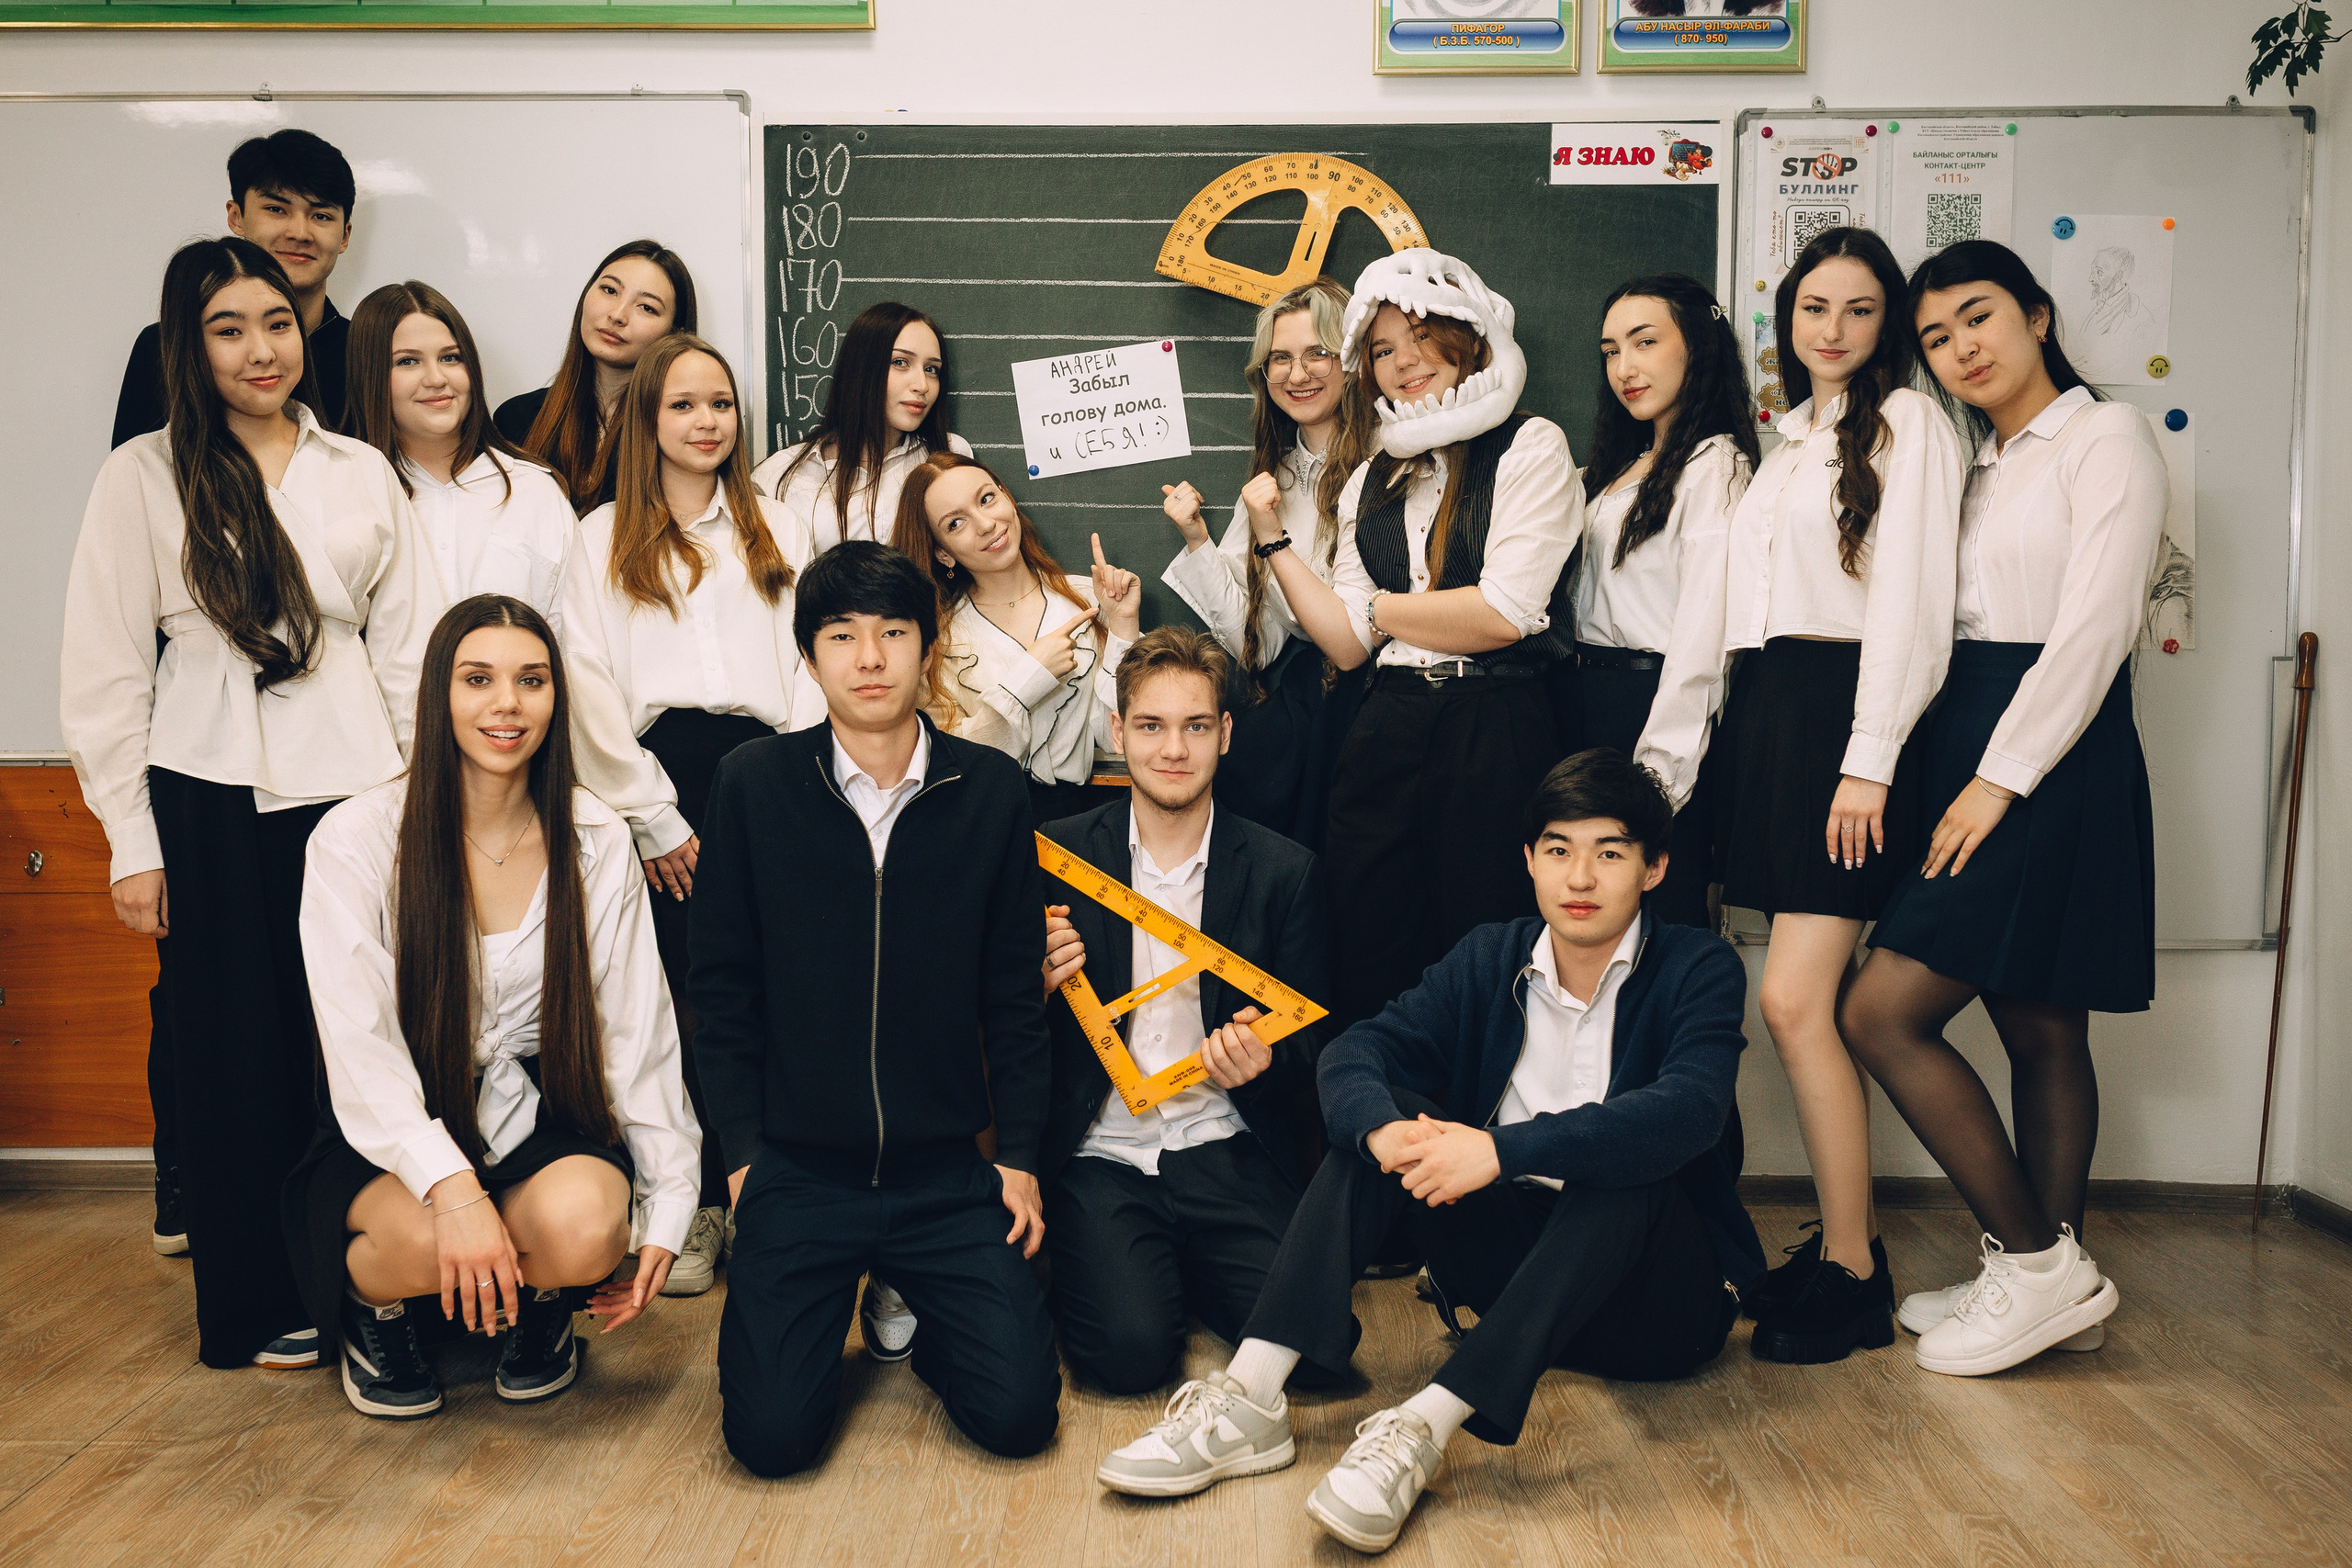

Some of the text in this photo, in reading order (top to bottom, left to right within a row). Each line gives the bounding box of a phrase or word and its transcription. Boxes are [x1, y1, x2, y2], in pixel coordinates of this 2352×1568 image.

[1451, 23, 1506, 34] ПИФАГОР
[1473, 36, 1513, 46] 570-500
[1634, 20, 1771, 32] АБУ НАСЫР ӘЛ-ФАРАБИ
[786, 142, 851, 199] 190
[1553, 146, 1656, 166] Я ЗНАЮ
[1912, 151, 1955, 159] БАЙЛАНЫС
[1177, 232, 1185, 242] 10
[1189, 213, 1198, 223] 20
[1204, 197, 1214, 206] 30
[1222, 183, 1231, 192] 40
[1242, 172, 1251, 181] 50
[1329, 171, 1340, 182] 90
[1351, 175, 1363, 186] 100
[1370, 186, 1383, 198] 110
[1387, 202, 1398, 214] 120
[1401, 220, 1411, 232] 130
[1779, 184, 1859, 195] БУЛЛИНГ
[782, 201, 842, 256] 180
[1177, 254, 1185, 267] 180
[1184, 235, 1194, 248] 170
[1195, 218, 1206, 231] 160
[1209, 202, 1221, 214] 150
[1226, 189, 1238, 200] 140
[1244, 180, 1257, 190] 130
[1264, 175, 1277, 183] 120
[1347, 184, 1356, 193] 80
[1364, 195, 1374, 205] 70
[1380, 209, 1389, 219] 60
[1393, 226, 1401, 235] 50
[779, 257, 842, 313] 170
[777, 316, 838, 368] 160
[1069, 374, 1130, 394] Забыл
[1041, 397, 1167, 426] голову дома.
[1057, 867, 1304, 1022] 40 60 80 100 120 140 160
[1060, 861, 1306, 1015] 20 30 40 50 60 70 80
[1067, 976, 1148, 1108] 20 10 0
